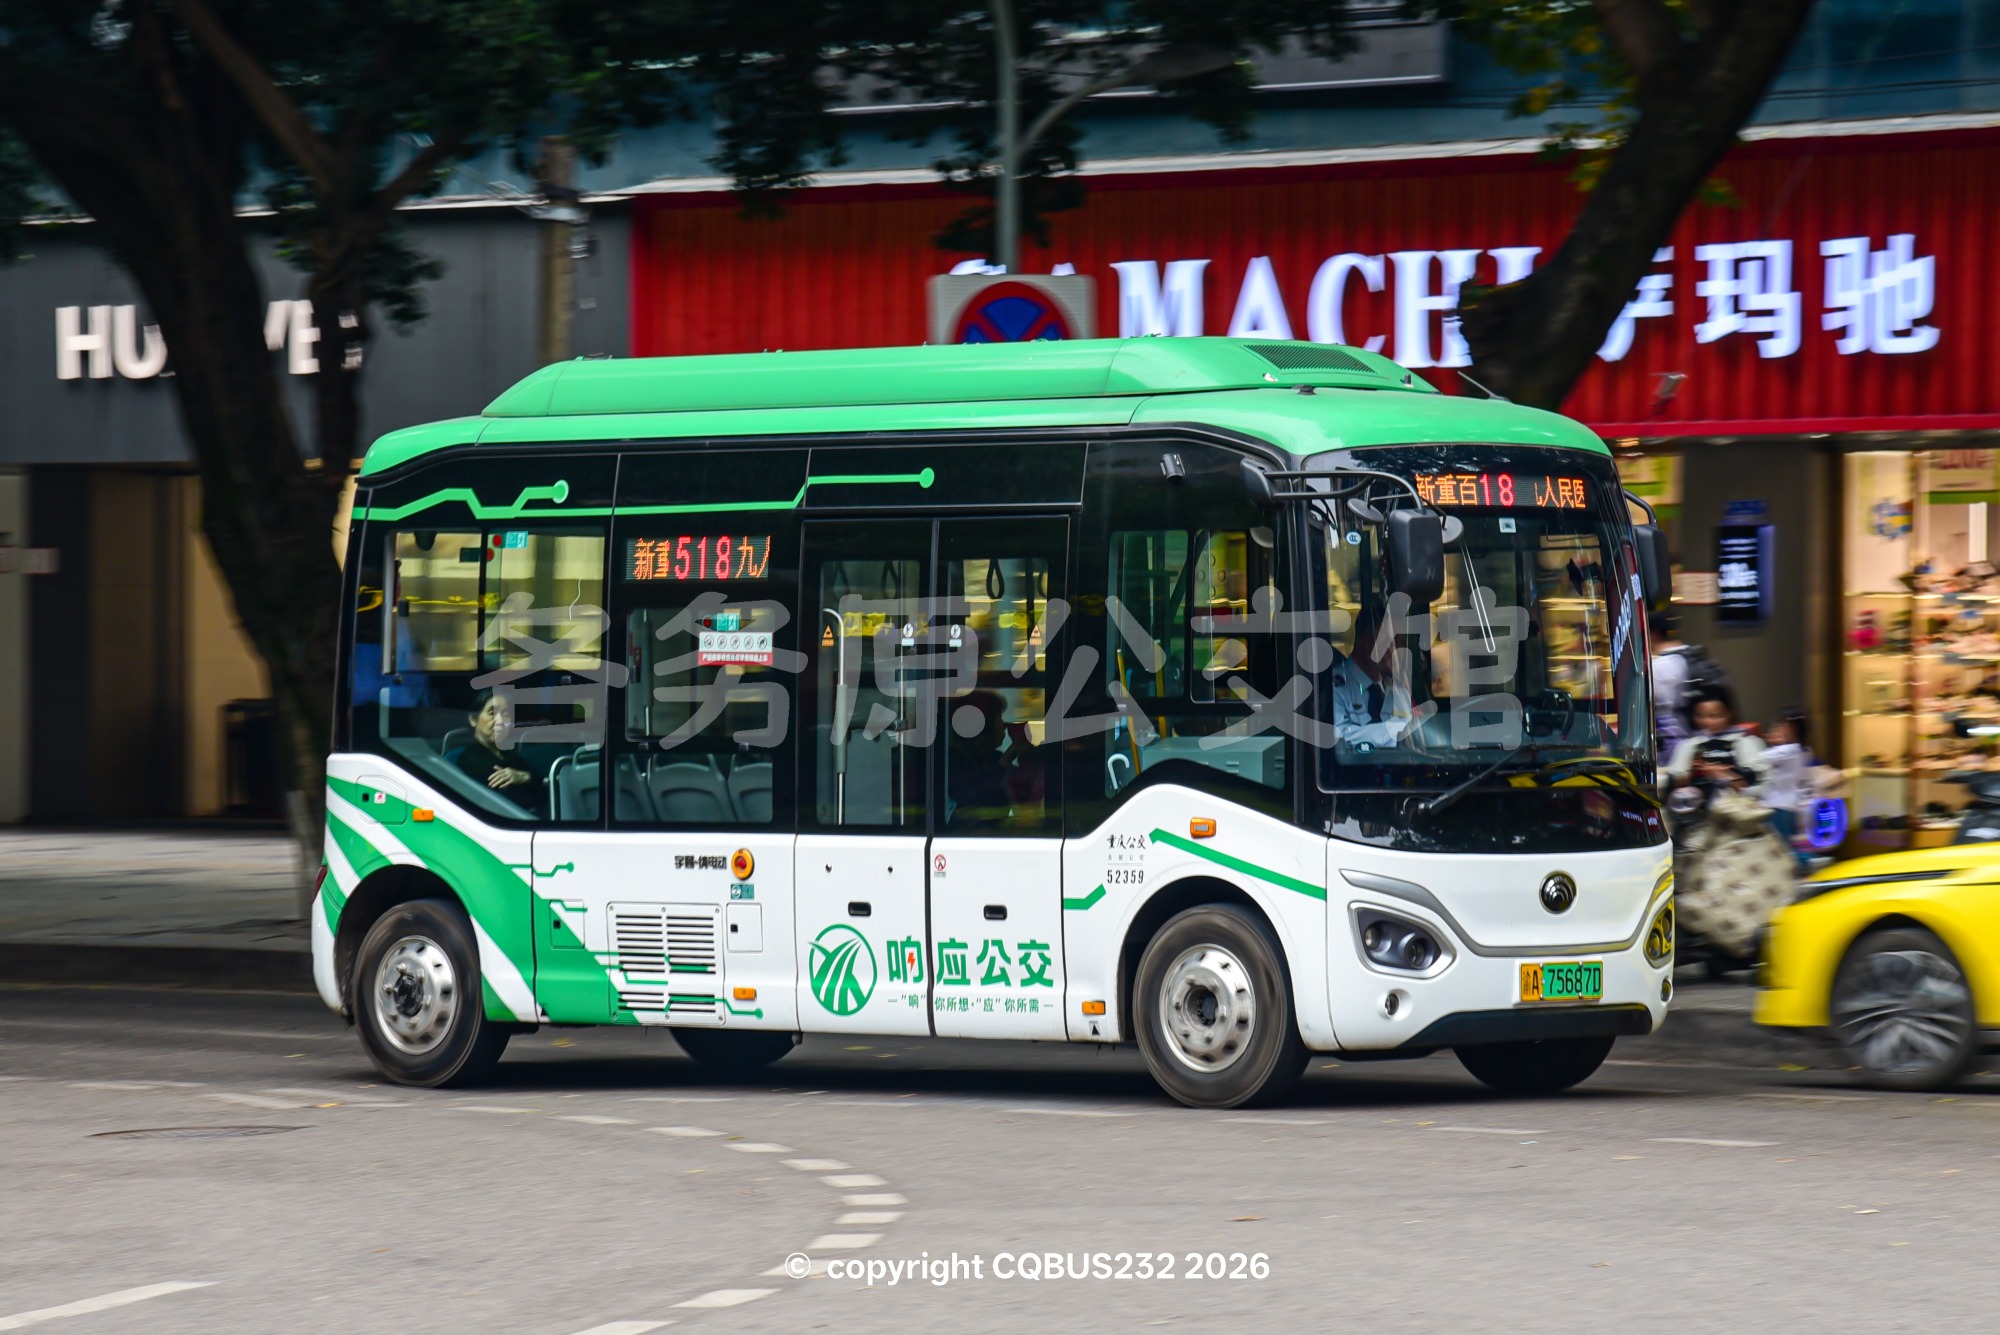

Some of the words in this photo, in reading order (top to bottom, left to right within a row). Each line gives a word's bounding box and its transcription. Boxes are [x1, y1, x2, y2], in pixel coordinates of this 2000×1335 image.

[674, 536, 731, 580] 518
[1107, 869, 1144, 884] 52359
[886, 935, 1054, 987] 响应公交
